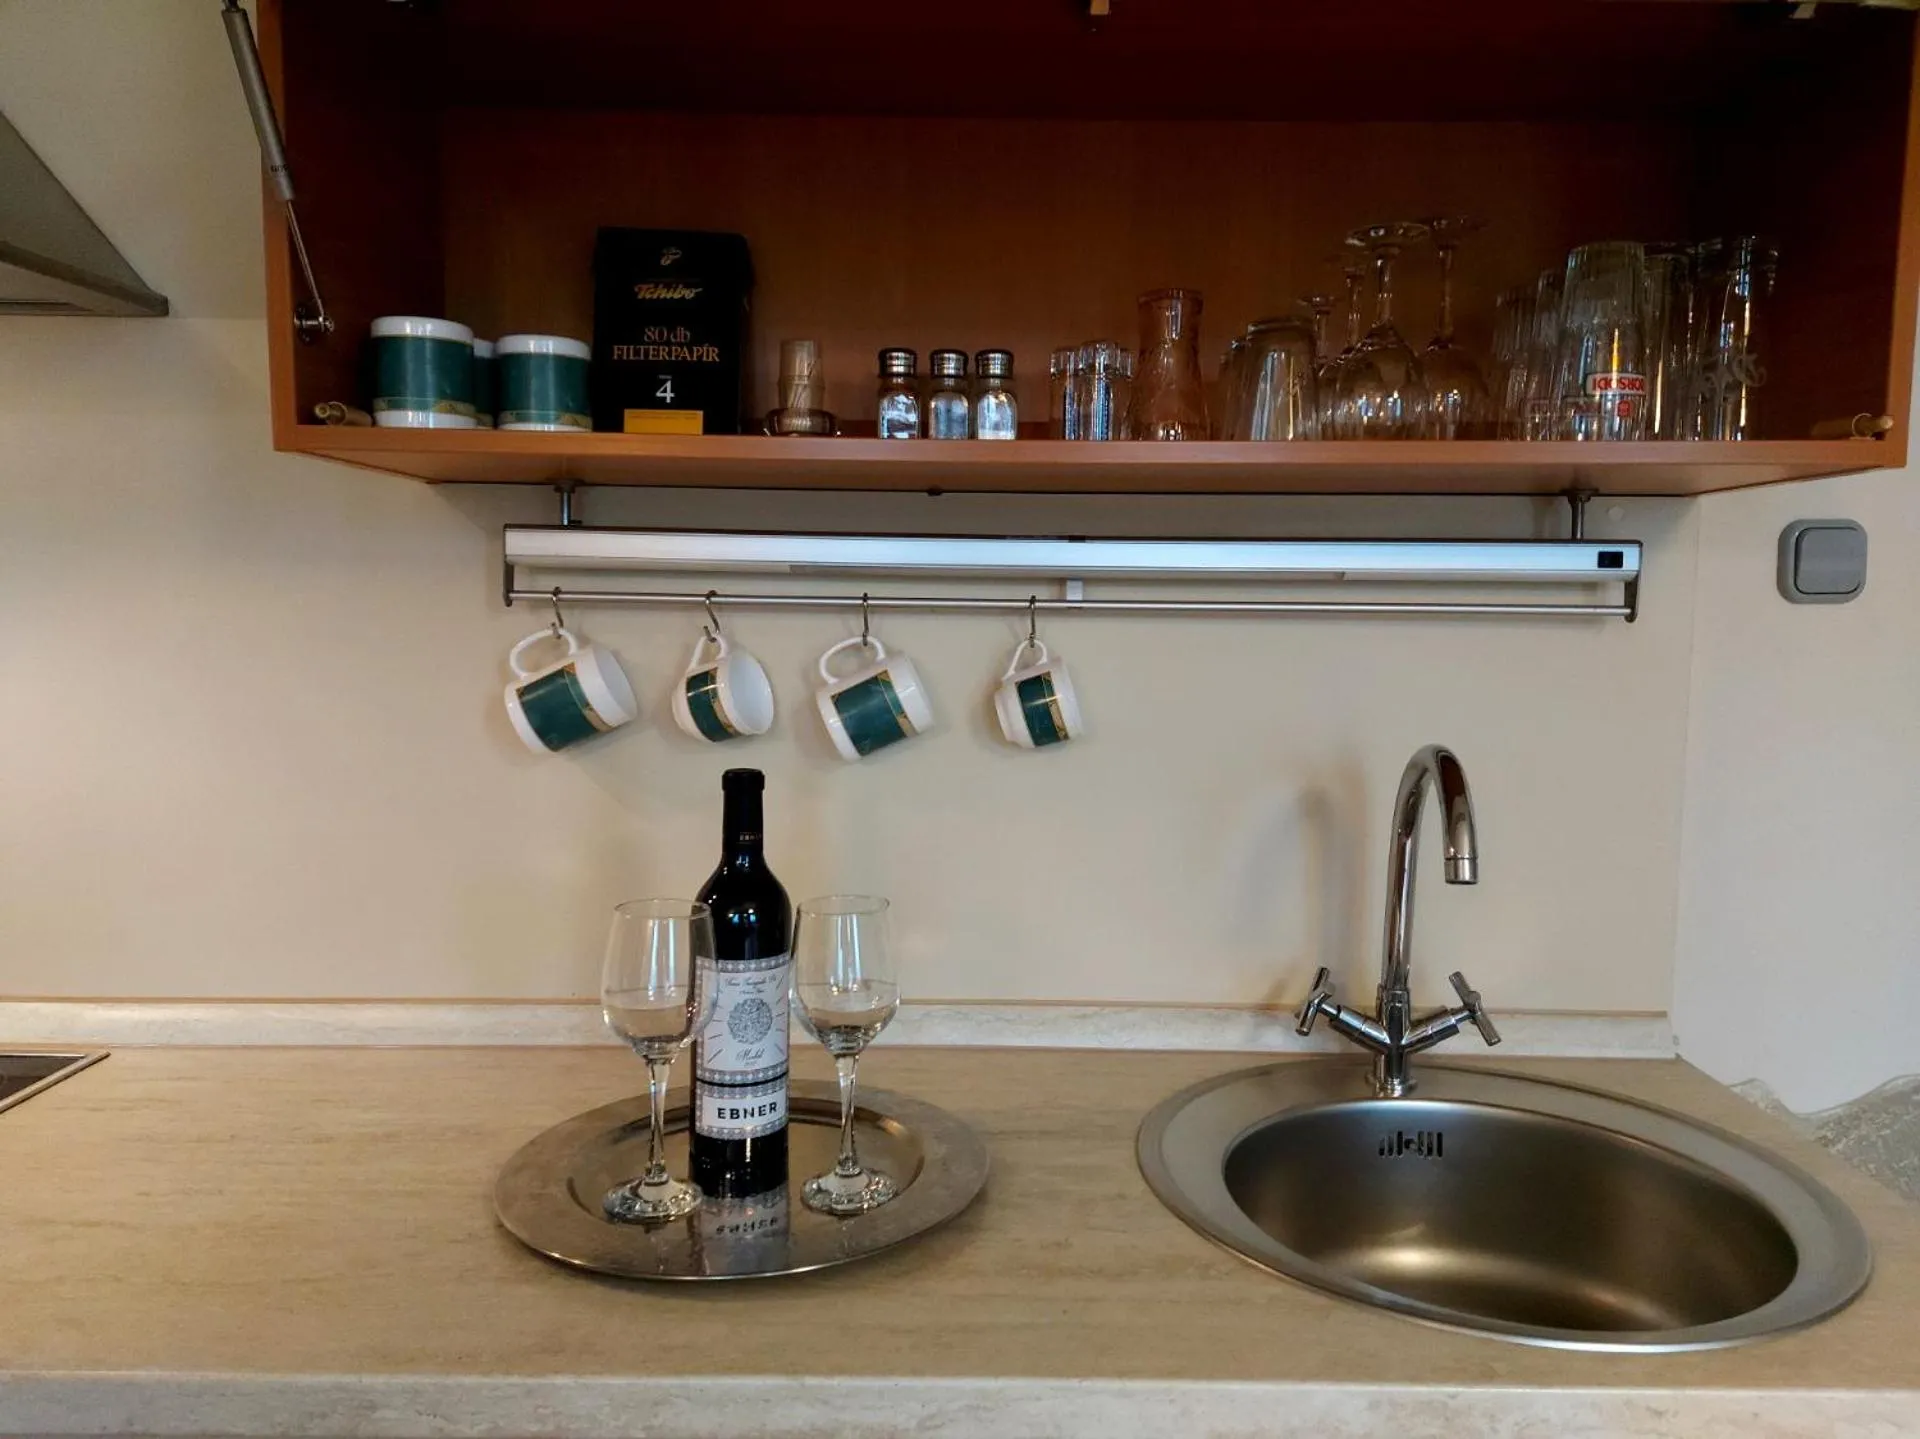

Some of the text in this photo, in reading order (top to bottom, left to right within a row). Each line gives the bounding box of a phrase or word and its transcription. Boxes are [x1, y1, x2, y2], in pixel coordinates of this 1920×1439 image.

[634, 284, 703, 300] Tchibo
[643, 326, 691, 343] 80 db
[612, 343, 720, 363] FILTERPAPÍR
[655, 380, 676, 403] 4
[717, 1101, 778, 1120] EBNER
